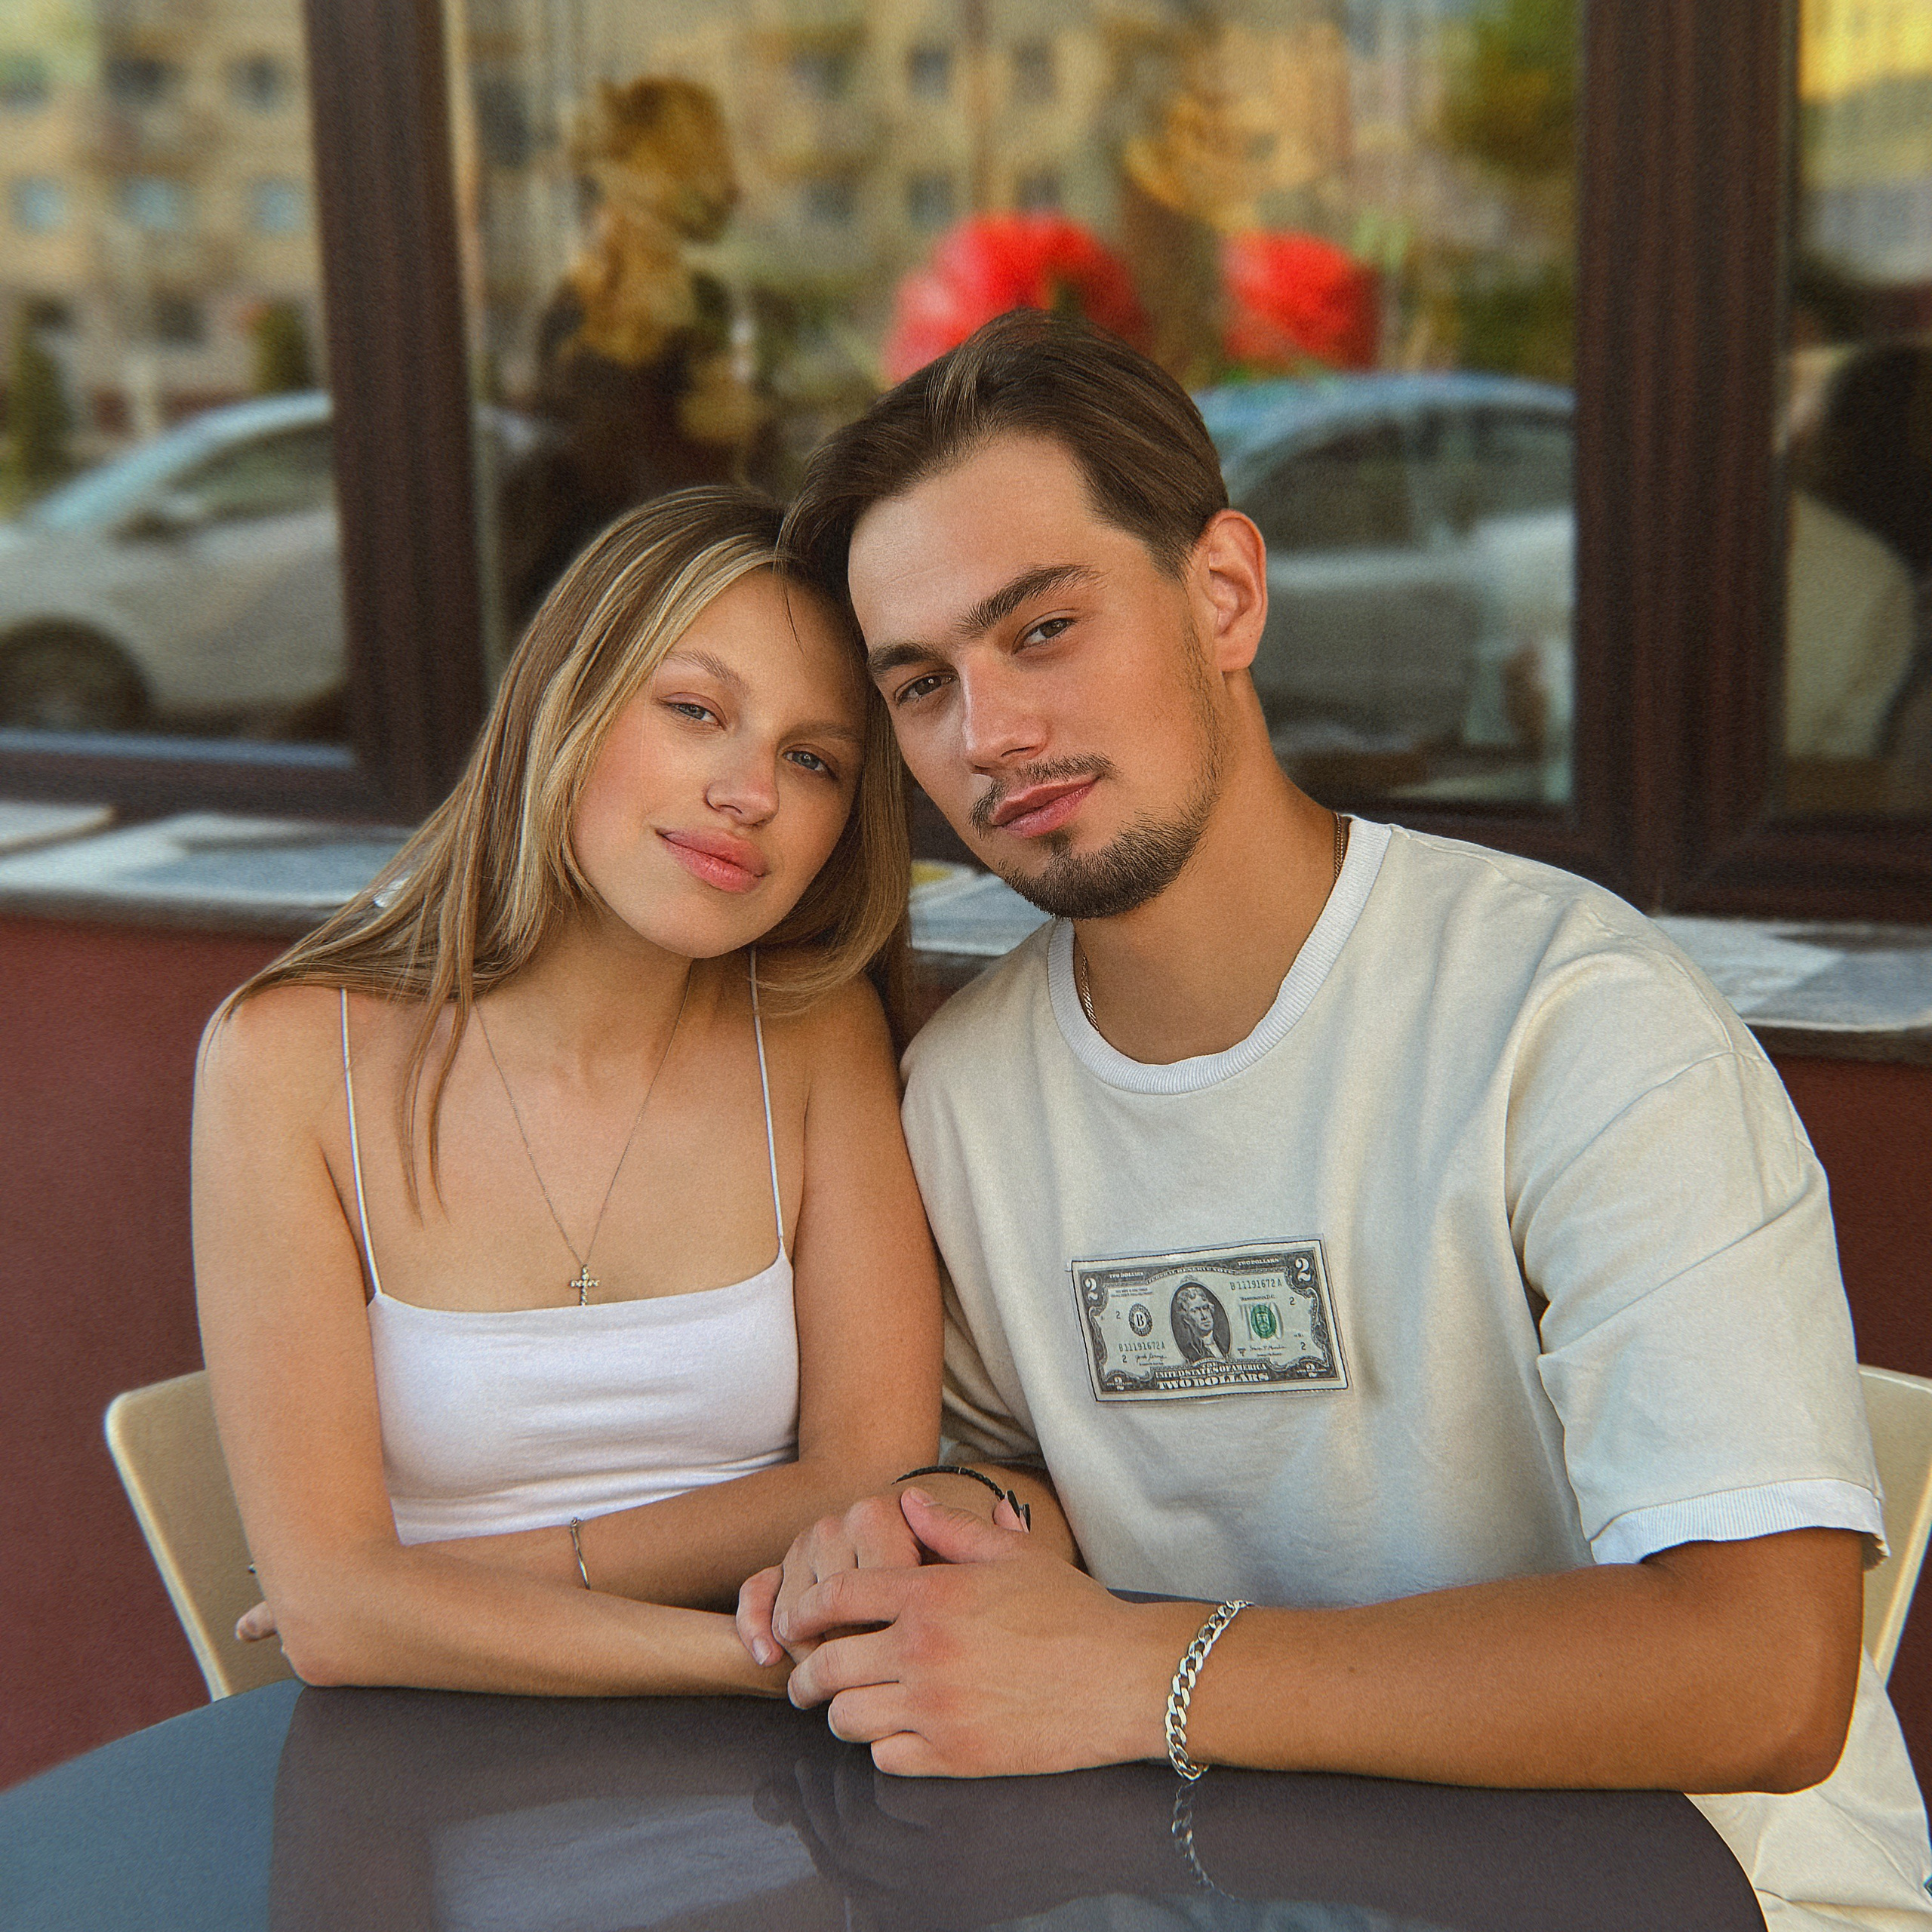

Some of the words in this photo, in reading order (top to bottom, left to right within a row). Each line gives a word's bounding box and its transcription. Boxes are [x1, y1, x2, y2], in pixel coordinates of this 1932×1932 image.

[1294, 1257, 1312, 1282] 2
[1084, 1278, 1098, 1300] 2
[1289, 1297, 1296, 1306] 2
[1115, 1310, 1121, 1319] 2
[1136, 1313, 1145, 1327] B
[1300, 1341, 1306, 1351] 2
[1121, 1355, 1128, 1364] 2
[1306, 1363, 1318, 1378] 2
[1114, 1377, 1124, 1390] 2
[1156, 1379, 1192, 1390] TWO
[1193, 1372, 1269, 1387] DOLLARS
